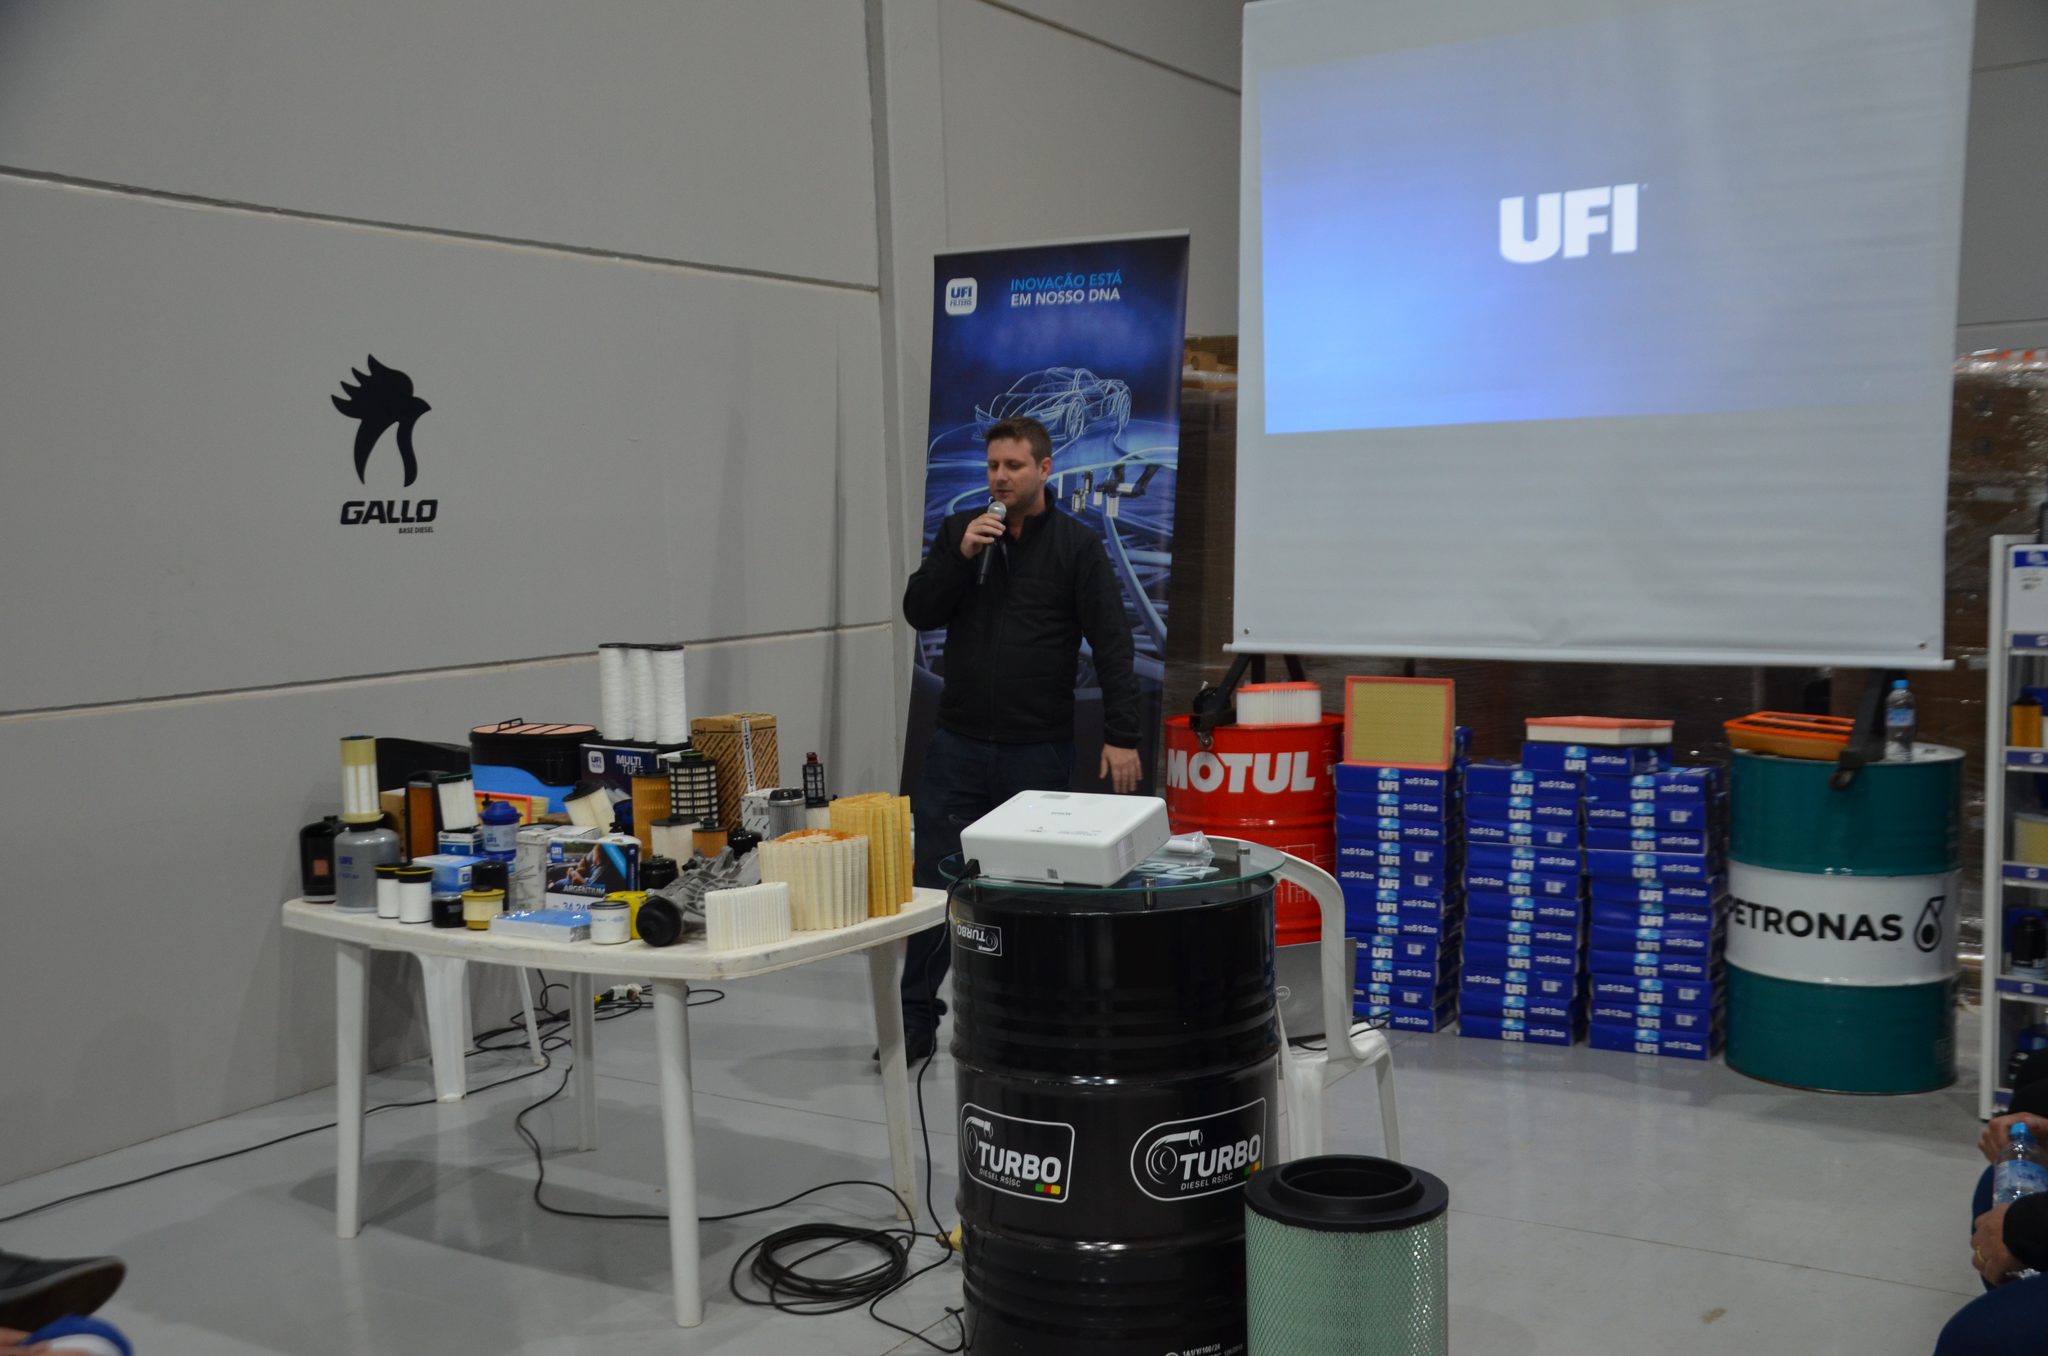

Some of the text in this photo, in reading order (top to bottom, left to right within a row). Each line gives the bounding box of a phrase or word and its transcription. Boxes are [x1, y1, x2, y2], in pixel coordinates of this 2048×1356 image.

[1499, 183, 1639, 264] UFI
[1011, 269, 1123, 291] INOVAÇÃO ESTÁ
[950, 286, 972, 298] UFI
[1011, 287, 1121, 308] EM NOSSO DNA
[340, 499, 438, 525] GALLO
[615, 754, 642, 766] MULTI
[1166, 748, 1316, 794] MOTUL
[957, 924, 986, 942] TURBO
[978, 1140, 1062, 1184] TURBO
[1180, 1134, 1261, 1181] TURBO
[979, 1167, 999, 1181] DIESEL
[1180, 1181, 1210, 1191] DIESEL
